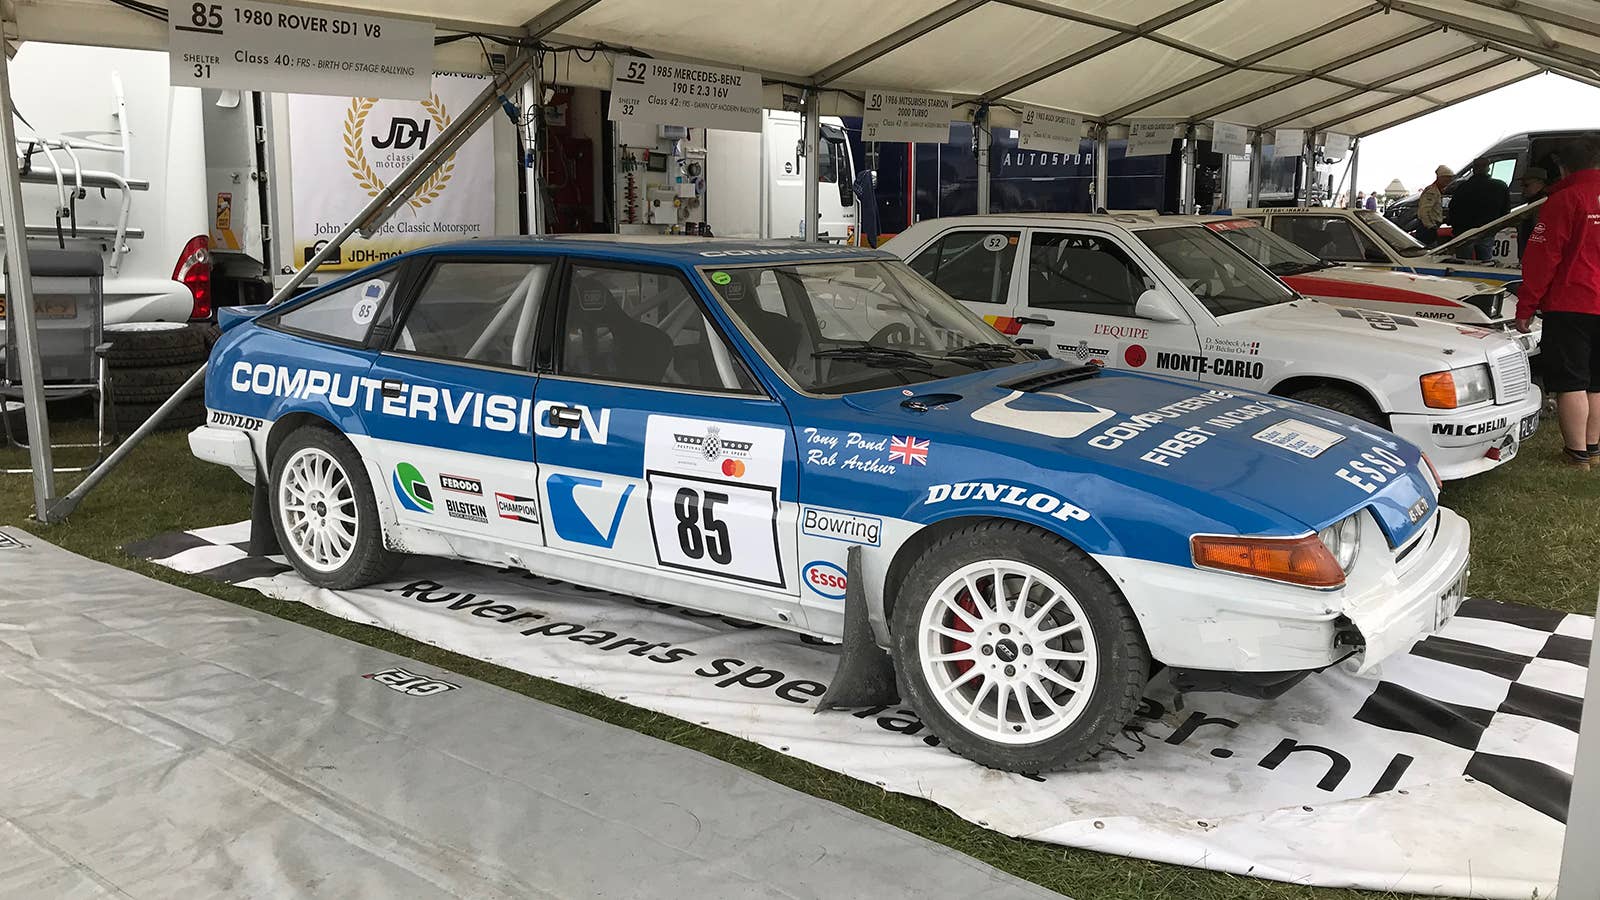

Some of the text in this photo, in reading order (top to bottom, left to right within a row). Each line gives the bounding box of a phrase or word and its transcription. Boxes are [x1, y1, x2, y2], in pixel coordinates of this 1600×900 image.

[191, 2, 223, 28] 85
[234, 8, 381, 38] 1980 ROVER SD1 V8
[183, 53, 220, 65] SHELTER
[234, 50, 269, 65] Class
[274, 54, 294, 67] 40:
[296, 57, 311, 68] FRS
[318, 60, 340, 70] BIRTH
[341, 62, 353, 71] OF
[355, 63, 379, 73] STAGE
[380, 65, 415, 76] RALLYING
[194, 63, 211, 78] 31
[626, 61, 647, 80] 52
[652, 65, 742, 87] 1985 MERCEDES-BENZ
[647, 94, 667, 106] Class
[672, 82, 729, 98] 190 E 2.3 16V
[622, 105, 634, 115] 32
[871, 93, 882, 108] 50
[371, 117, 430, 150] JDH
[314, 223, 341, 236] John
[399, 222, 431, 233] Classic
[432, 223, 481, 236] Motorsport
[989, 238, 1001, 248] 52
[1492, 239, 1510, 257] 30
[358, 304, 372, 318] 85
[1415, 310, 1456, 320] SAMPO
[1093, 323, 1149, 340] L'EQUIPE
[1156, 351, 1264, 380] MONTE-CARLO
[231, 360, 611, 446] COMPUTERVISION
[211, 411, 263, 431] DUNLOP
[1432, 417, 1508, 437] MICHELIN
[803, 427, 888, 452] Tony Pond
[1140, 426, 1217, 467] FIRST
[806, 448, 896, 475] Rob Arthur
[1335, 446, 1406, 494] ESSO
[442, 477, 480, 493] FERODO
[445, 498, 487, 518] BILSTEIN
[498, 500, 537, 517] CHAMPION
[924, 482, 1092, 523] DUNLOP
[673, 487, 733, 566] 85
[804, 510, 880, 544] Bowring
